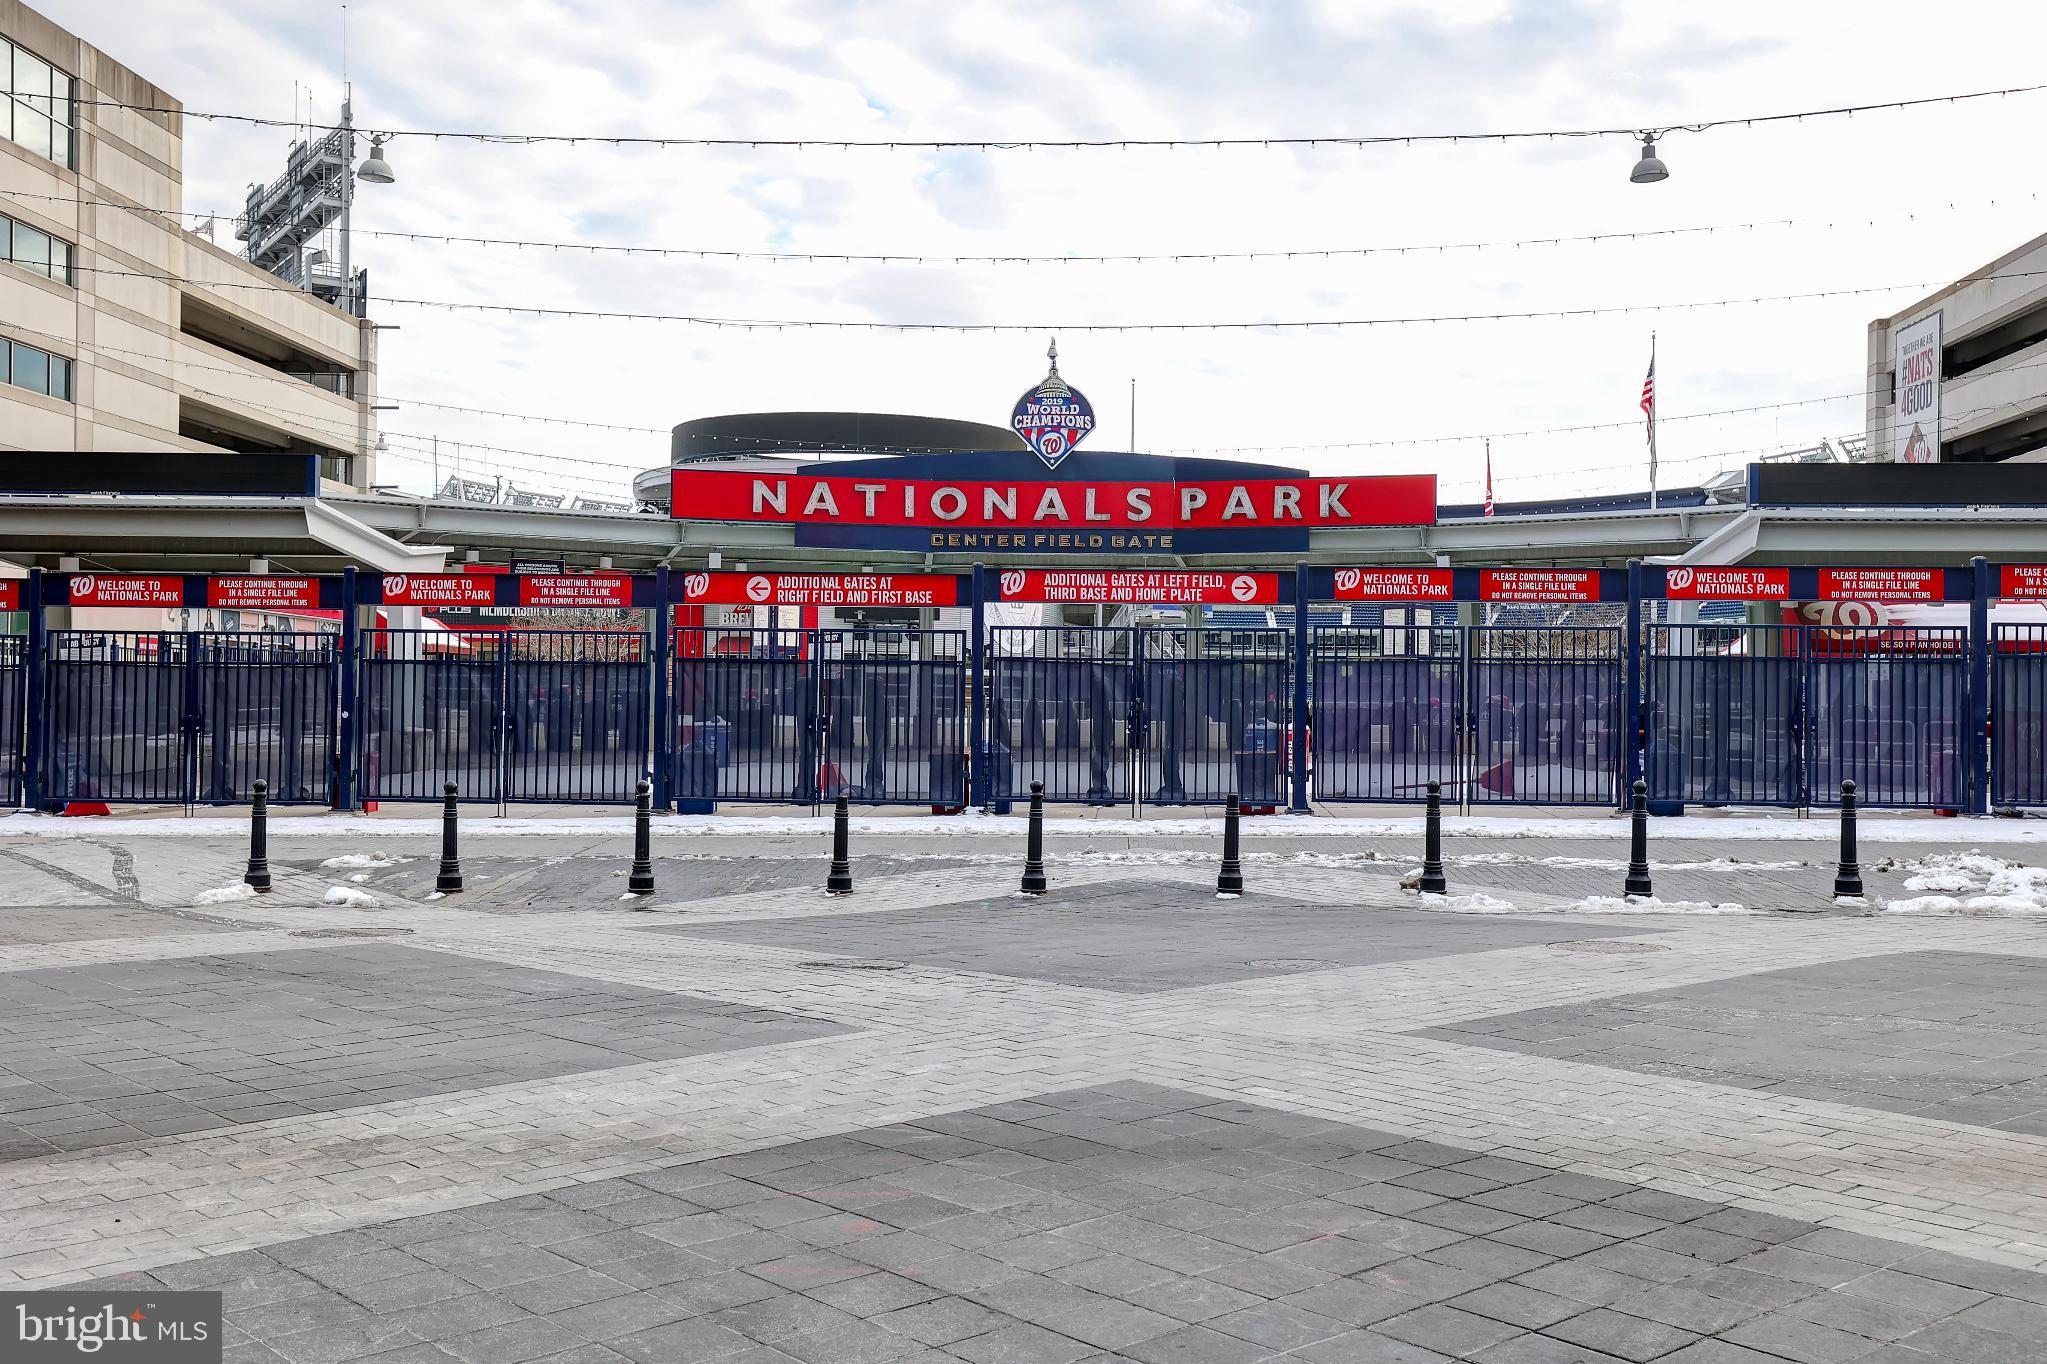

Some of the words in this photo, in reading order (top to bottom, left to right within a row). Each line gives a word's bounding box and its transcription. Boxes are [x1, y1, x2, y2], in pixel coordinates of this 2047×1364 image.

[1926, 332, 1934, 344] ARE
[1902, 347, 1934, 386] #NATS
[1901, 379, 1932, 418] 4GOOD
[1026, 403, 1080, 415] WORLD
[1014, 415, 1092, 429] CHAMPIONS
[752, 480, 1152, 522] NATIONALS
[1180, 482, 1352, 521] PARK
[931, 534, 1026, 547] CENTER
[1034, 534, 1102, 548] FIELD
[1112, 534, 1172, 548] GATE
[1897, 572, 1931, 580] THROUGH
[2015, 568, 2041, 576] PLEASE
[1044, 574, 1108, 586] ADDITIONAL
[1111, 574, 1144, 586] GATES
[1147, 574, 1160, 586] AT
[1163, 574, 1189, 587] LEFT
[1192, 575, 1226, 589] FIELD,
[1363, 574, 1413, 584] WELCOME
[1416, 574, 1429, 585] TO
[1519, 573, 1553, 581] CONTINUE
[1555, 573, 1587, 582] THROUGH
[1697, 573, 1748, 583] WELCOME
[1752, 573, 1764, 583] TO
[98, 581, 145, 591] WELCOME
[150, 581, 160, 591] TO
[410, 580, 457, 589] WELCOME
[461, 580, 472, 589] TO
[777, 576, 840, 589] ADDITIONAL
[844, 577, 876, 589] GATES
[879, 577, 892, 590] AT
[1518, 582, 1543, 590] SINGLE
[1545, 582, 1560, 590] FILE
[1858, 581, 1884, 589] SINGLE
[1363, 585, 1418, 594] NATIONALS
[1421, 585, 1448, 595] PARK
[1697, 584, 1753, 594] NATIONALS
[1757, 584, 1784, 594] PARK
[98, 591, 150, 601] NATIONALS
[153, 592, 178, 601] PARK
[410, 590, 462, 599] NATIONALS
[465, 591, 490, 600] PARK
[777, 591, 809, 603] RIGHT
[812, 591, 844, 603] FIELD
[847, 591, 868, 603] AND
[872, 592, 902, 604] FIRST
[905, 592, 932, 604] BASE
[1044, 588, 1076, 599] THIRD
[1080, 588, 1107, 600] BASE
[1110, 588, 1132, 600] AND
[1136, 588, 1166, 601] HOME
[1170, 589, 1202, 602] PLATE
